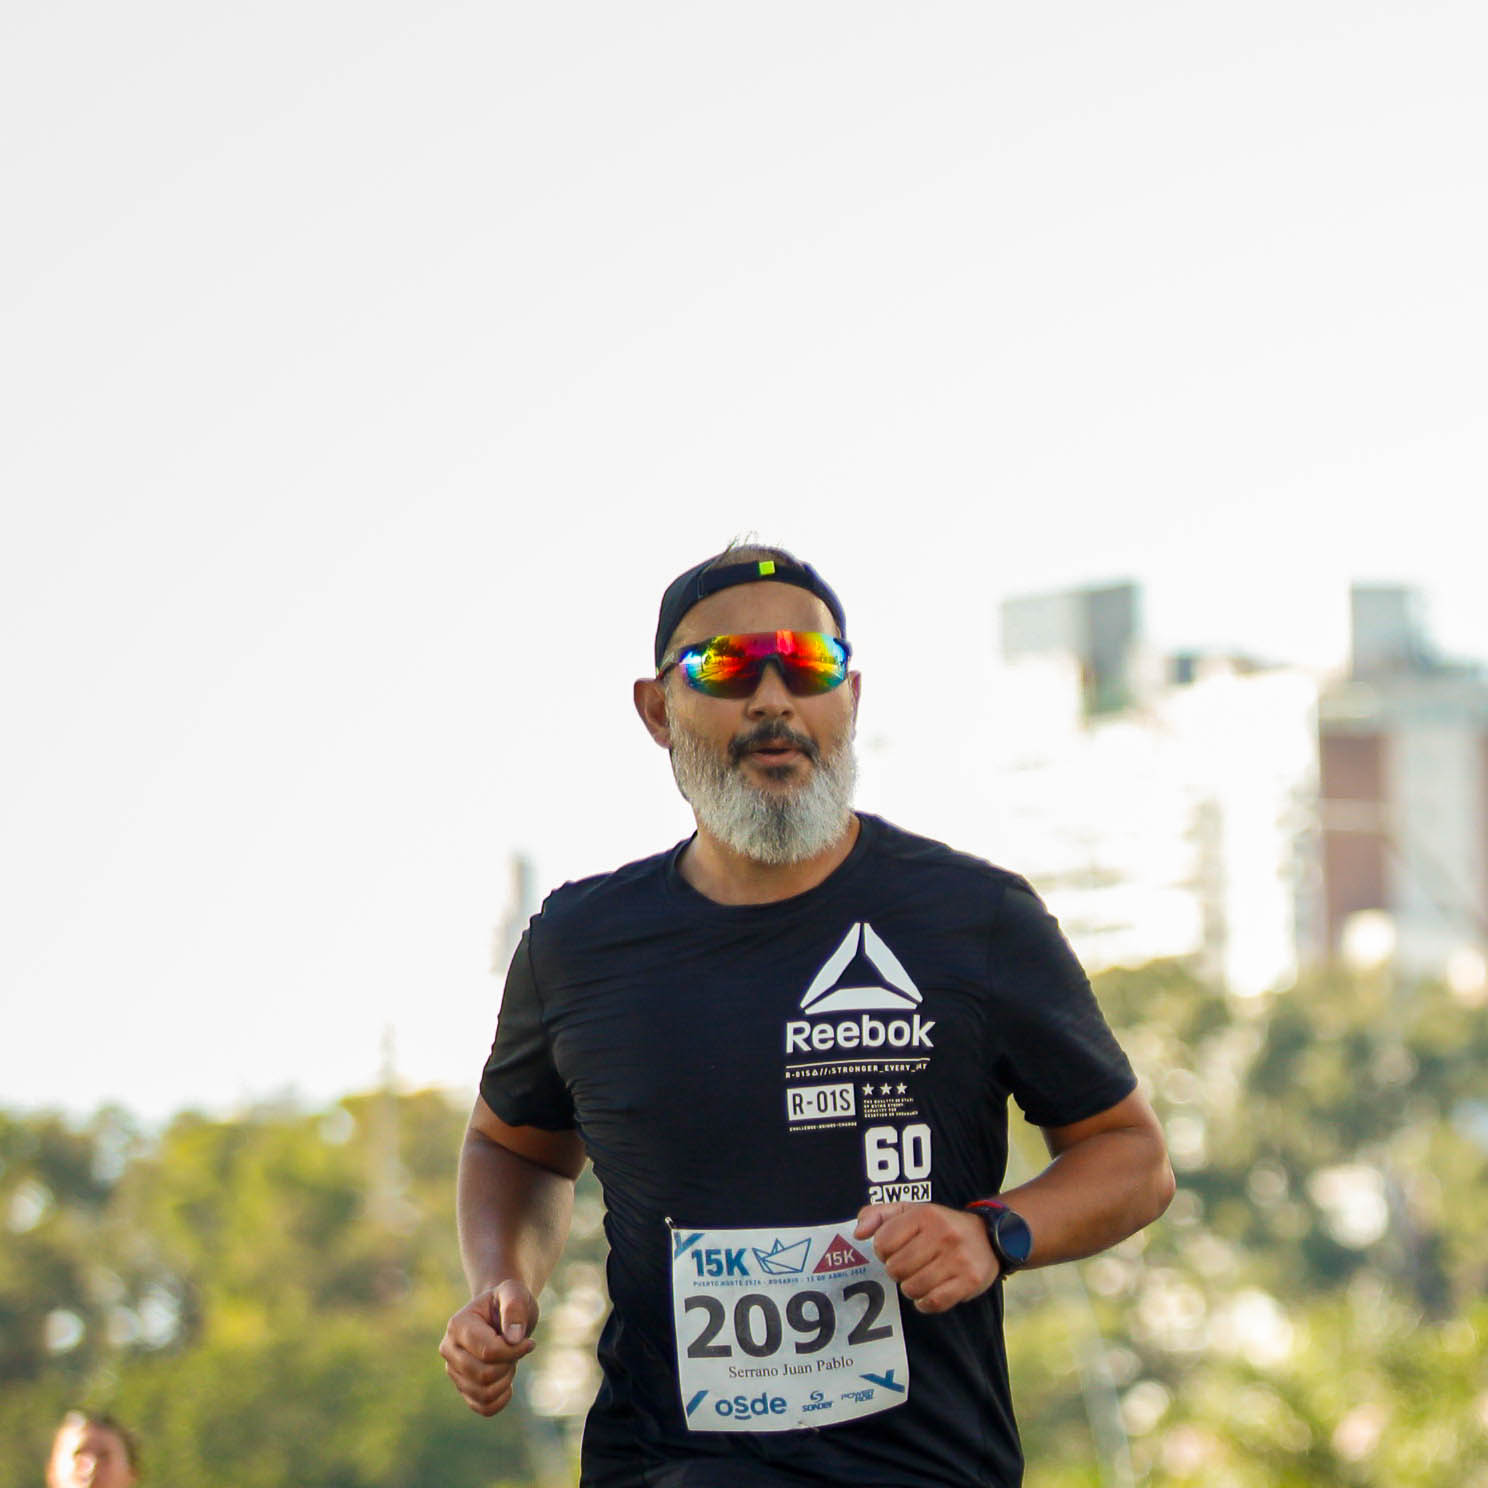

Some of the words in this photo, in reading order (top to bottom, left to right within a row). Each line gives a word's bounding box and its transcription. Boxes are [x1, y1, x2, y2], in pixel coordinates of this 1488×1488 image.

[785, 1014, 936, 1054] Reebok
[792, 1088, 851, 1116] R-01S
[865, 1123, 932, 1183] 60
[692, 1248, 749, 1277] 15K
[825, 1249, 857, 1267] 15K
[684, 1280, 893, 1358] 2092
[728, 1366, 778, 1378] Serrano
[782, 1362, 812, 1376] Juan
[817, 1357, 854, 1372] Pablo
[715, 1392, 787, 1419] osde
